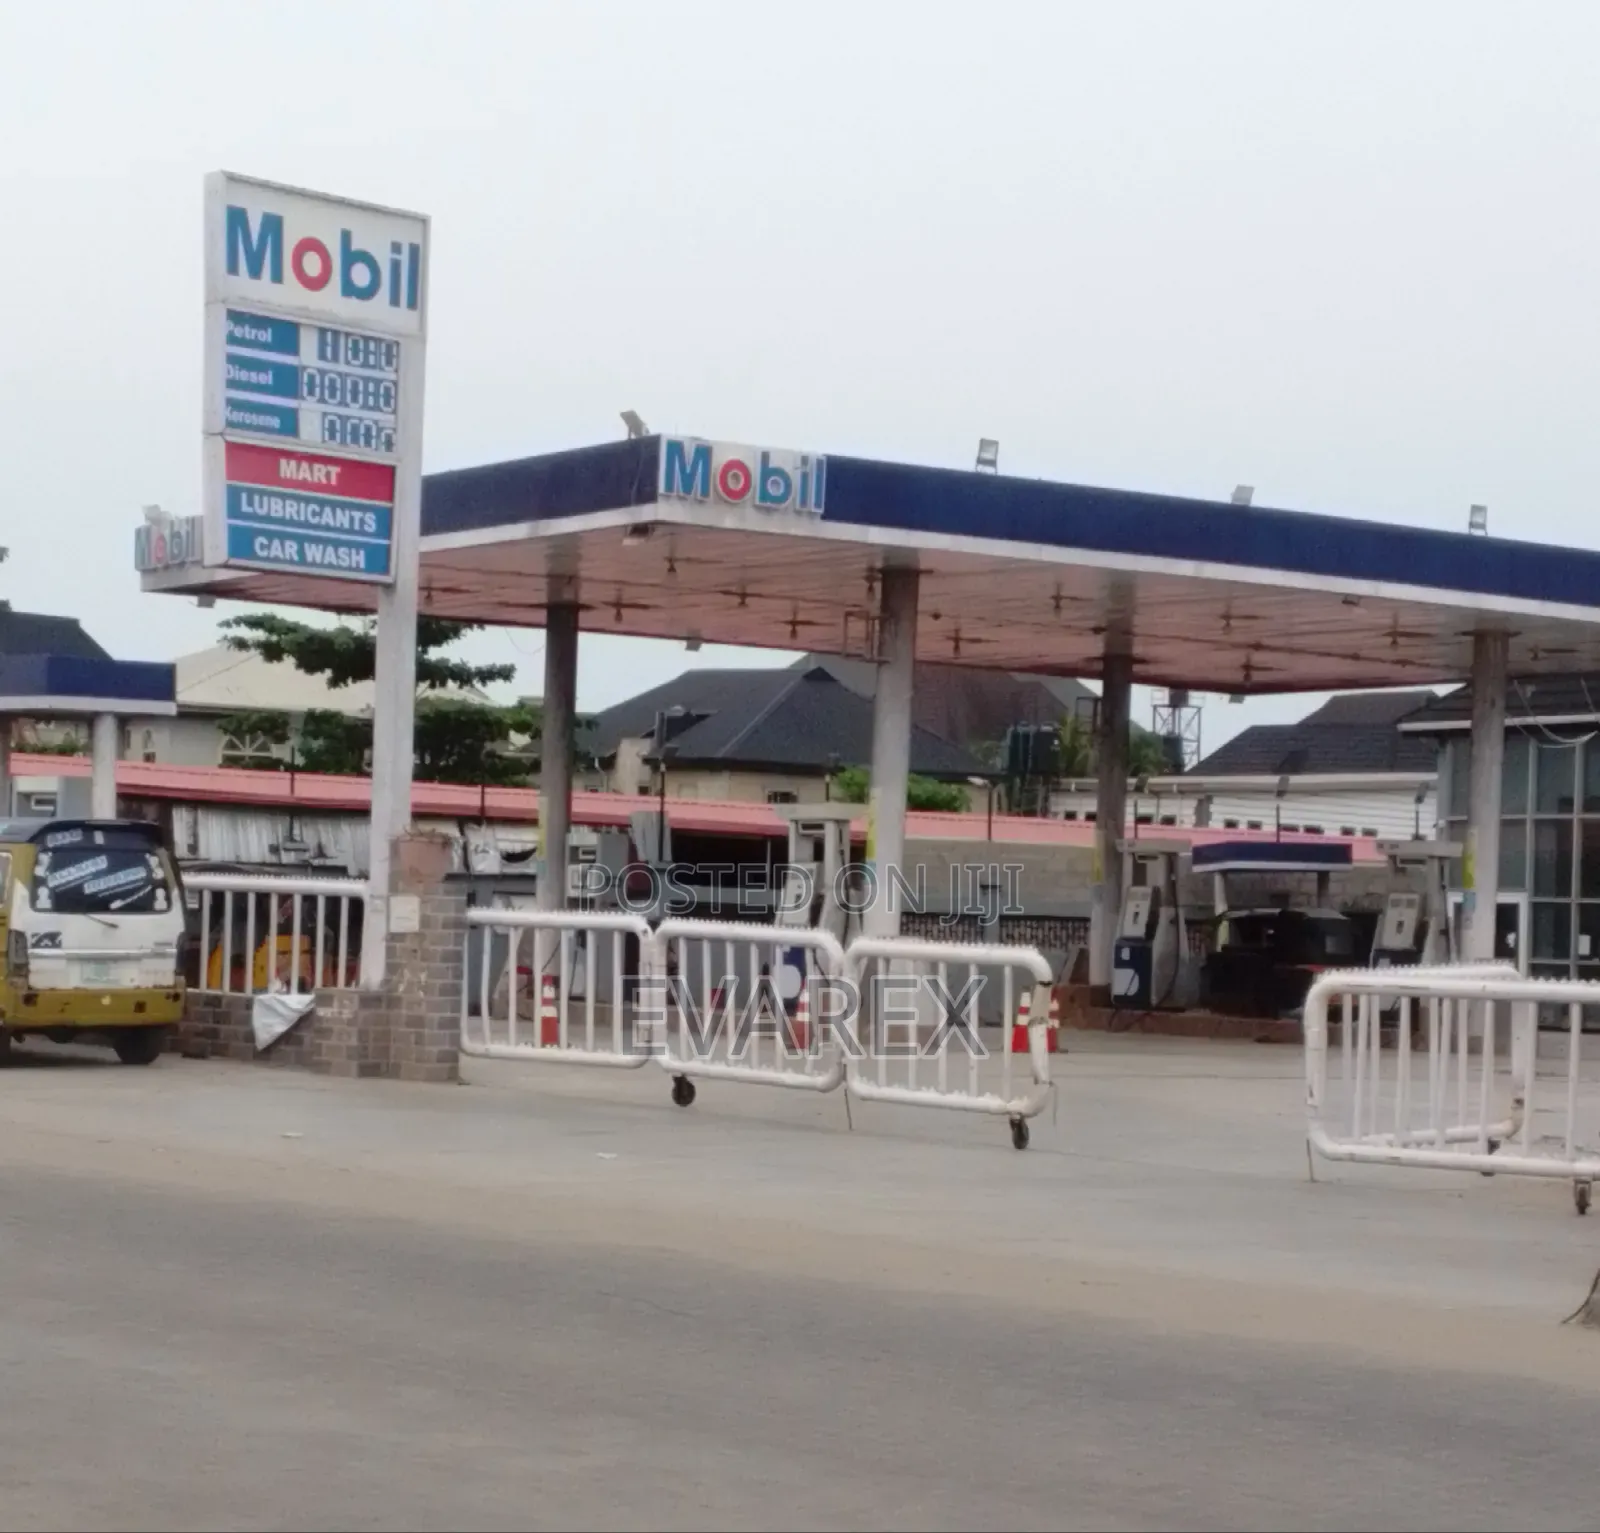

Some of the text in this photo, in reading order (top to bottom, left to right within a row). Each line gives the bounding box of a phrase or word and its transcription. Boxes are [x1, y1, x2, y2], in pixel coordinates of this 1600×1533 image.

[226, 204, 420, 311] Mobil
[226, 320, 272, 343] Petrol
[226, 363, 273, 385] Diesel
[279, 458, 341, 485] MART
[664, 438, 825, 511] Mobil
[240, 492, 377, 533] LUBRICANTS
[135, 515, 196, 571] Mobil
[254, 536, 366, 569] CAR WASH
